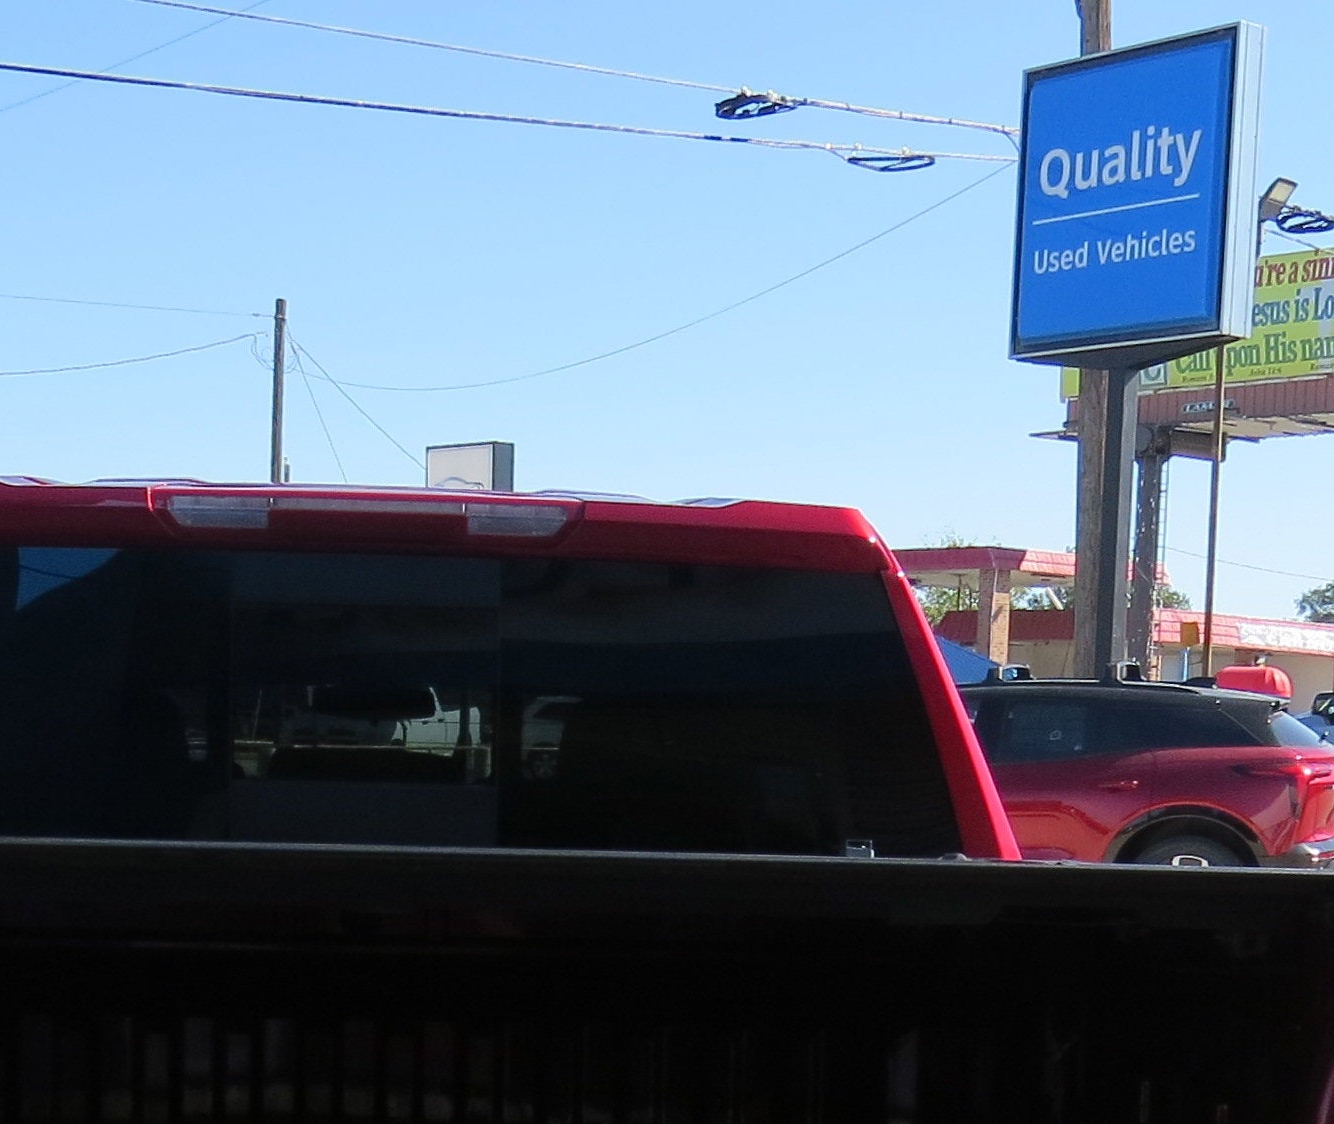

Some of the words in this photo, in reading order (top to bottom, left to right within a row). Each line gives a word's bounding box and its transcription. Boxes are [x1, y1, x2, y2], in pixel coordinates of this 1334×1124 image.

[1040, 126, 1202, 199] Quality
[1034, 241, 1088, 274] Used
[1097, 229, 1196, 265] Vehicles
[1255, 259, 1286, 287] u're
[1288, 261, 1299, 284] a
[1252, 302, 1290, 327] esus
[1295, 289, 1309, 323] is
[1215, 343, 1260, 377] pon
[1264, 332, 1298, 364] His
